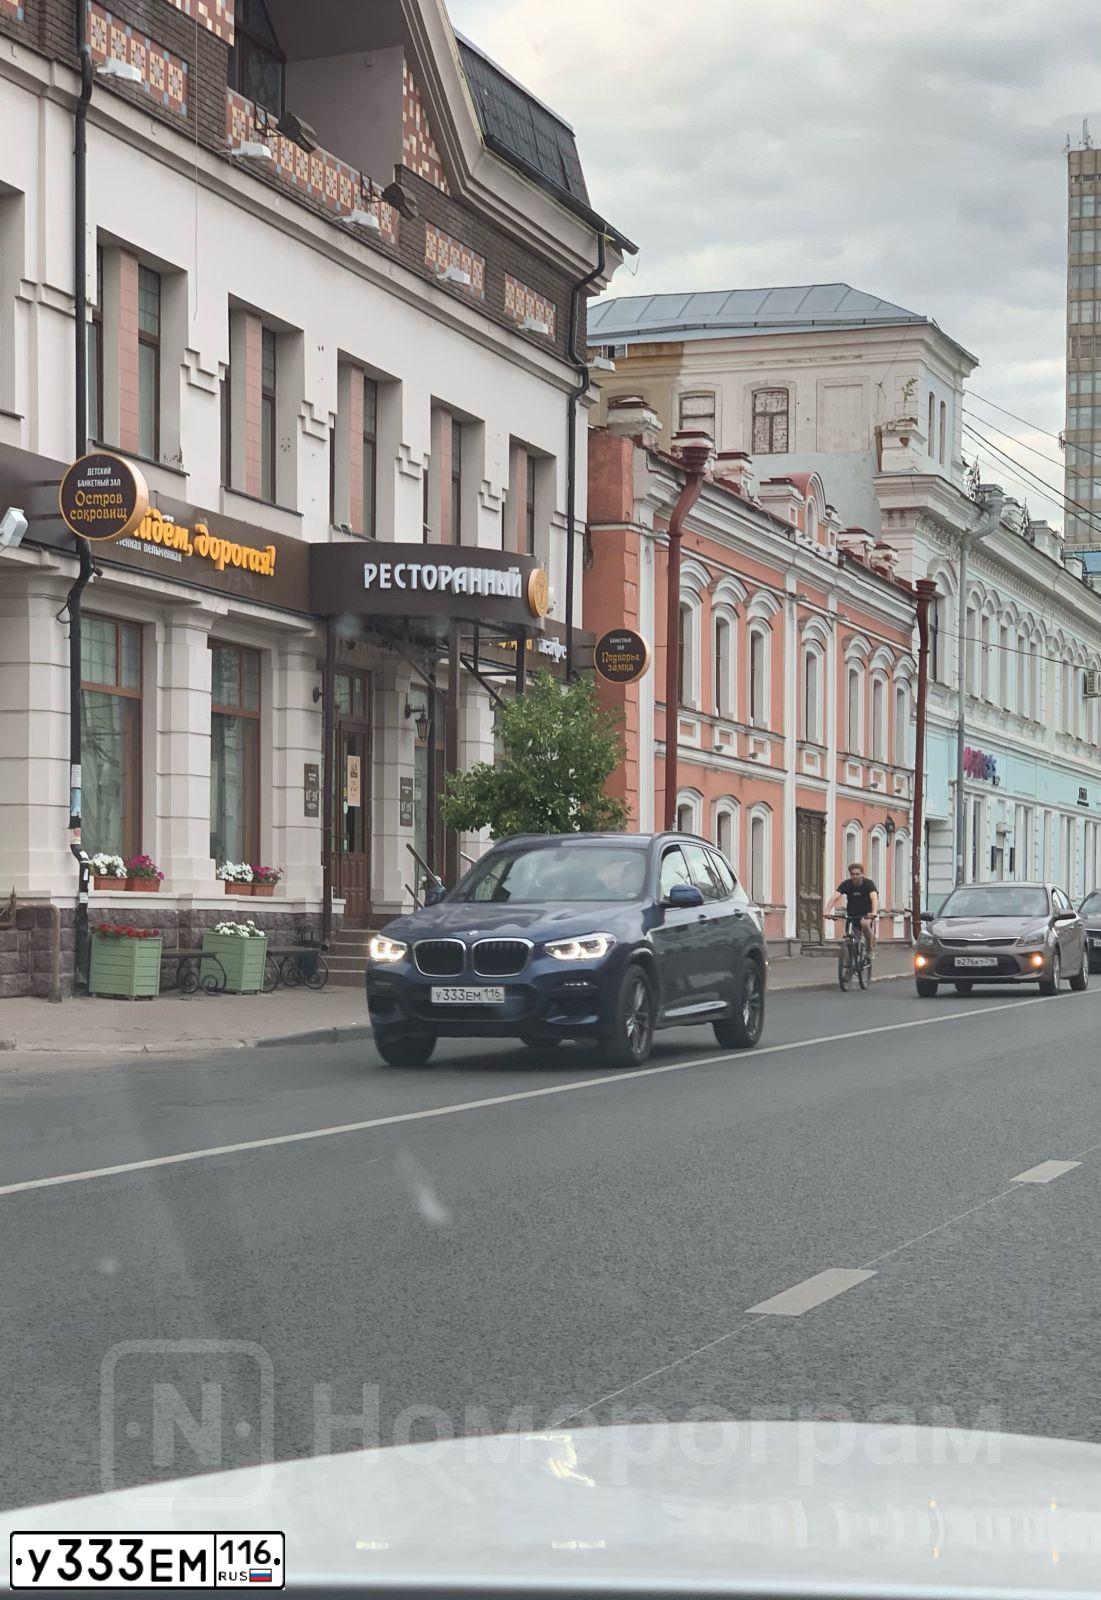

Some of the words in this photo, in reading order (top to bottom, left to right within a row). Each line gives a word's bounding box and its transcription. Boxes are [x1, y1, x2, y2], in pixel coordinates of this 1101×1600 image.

[87, 466, 112, 476] ДЕТСКИЙ
[77, 478, 109, 488] БАНКЕТНЫЙ
[110, 478, 121, 487] ЗАЛ
[75, 490, 123, 507] Остров
[69, 508, 128, 522] сокровищ
[194, 523, 276, 577] дорогая!
[364, 563, 522, 598] РЕСТОРАННЫЙ
[436, 988, 481, 1001] У333ЕМ
[483, 988, 501, 998] 116
